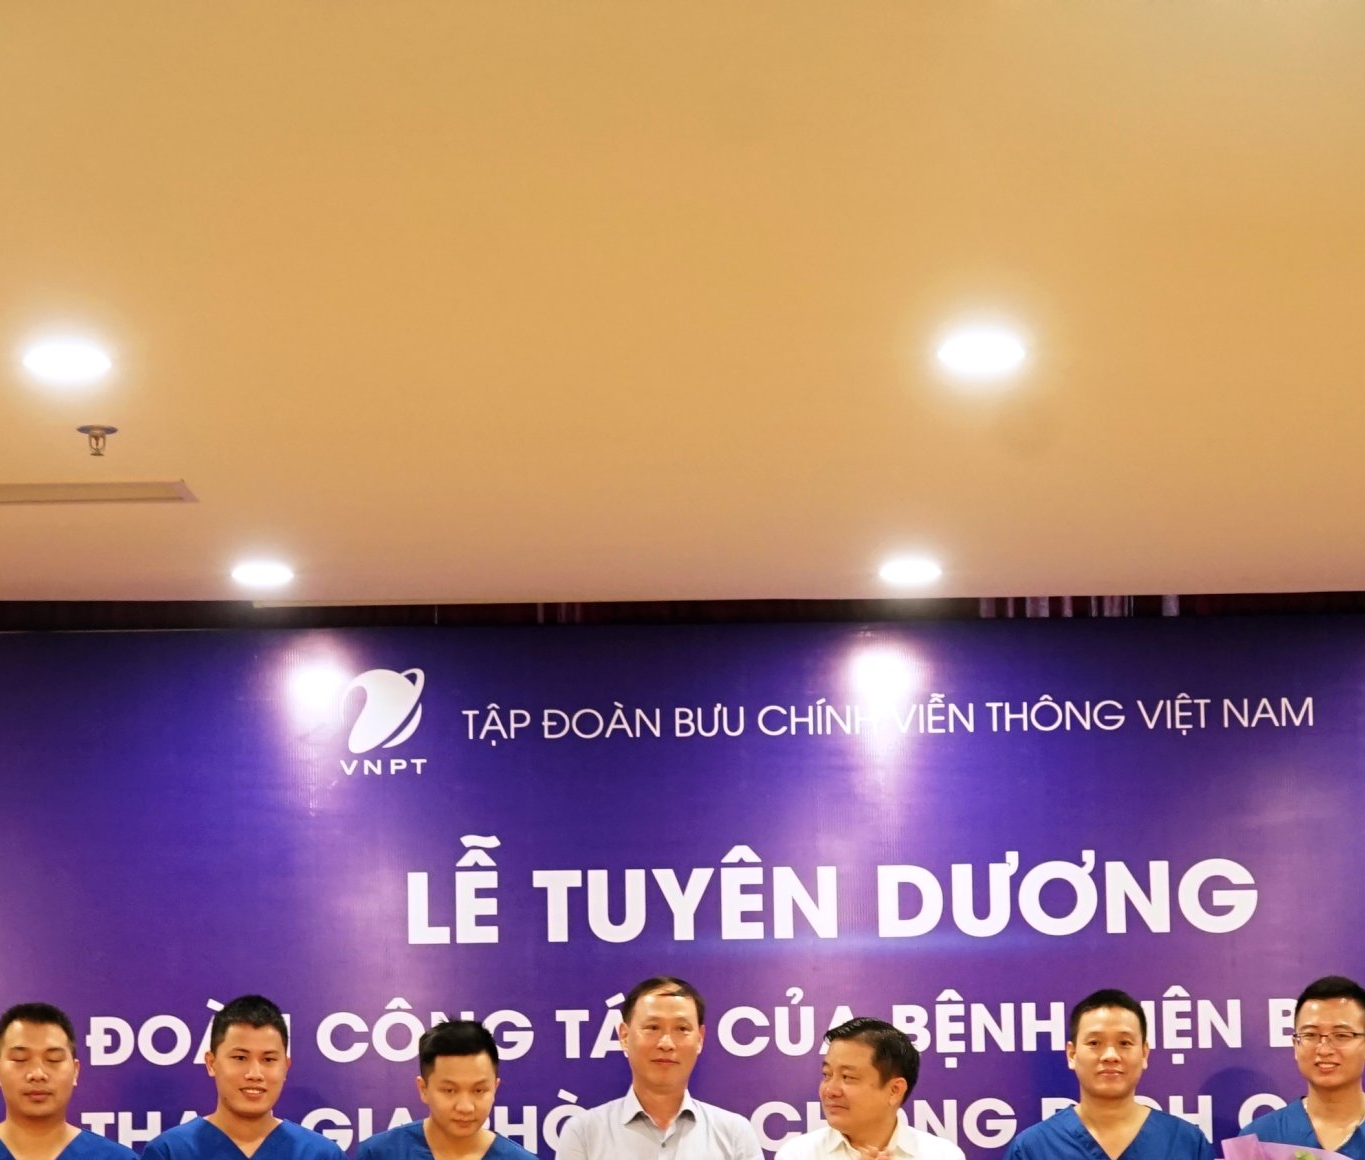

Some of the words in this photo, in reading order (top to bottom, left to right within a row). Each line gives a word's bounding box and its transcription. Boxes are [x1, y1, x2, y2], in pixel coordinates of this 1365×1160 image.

[462, 703, 531, 746] TẬP
[542, 702, 661, 739] ĐOÀN
[674, 703, 745, 737] BƯU
[891, 693, 974, 733] VIỄN
[985, 694, 1126, 731] THÔNG
[1137, 693, 1211, 735] VIỆT
[1223, 697, 1314, 727] NAM
[340, 758, 428, 775] VNPT
[407, 834, 502, 944] LỄ
[532, 844, 839, 943] TUYÊN
[877, 849, 1258, 938] DƯƠNG
[316, 997, 535, 1063] CÔG
[555, 992, 628, 1059] TÁ
